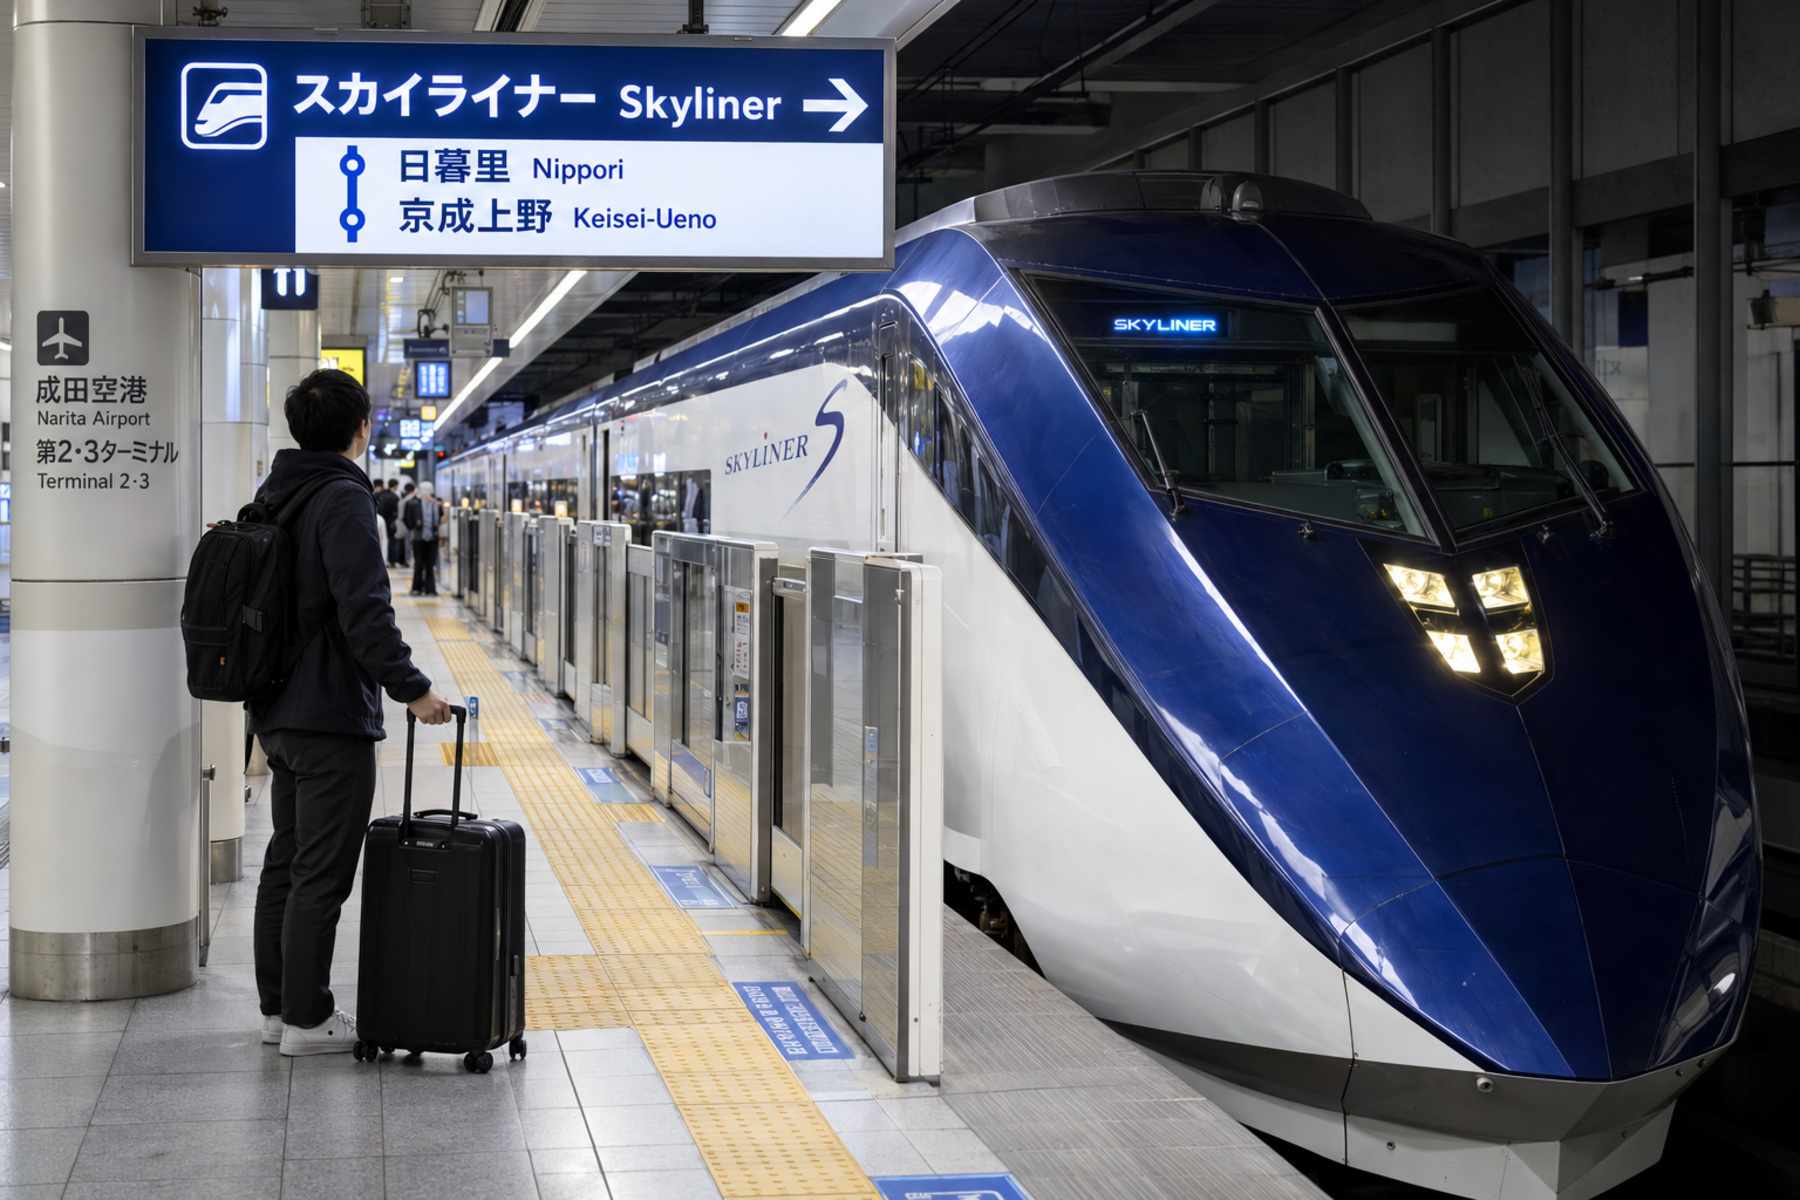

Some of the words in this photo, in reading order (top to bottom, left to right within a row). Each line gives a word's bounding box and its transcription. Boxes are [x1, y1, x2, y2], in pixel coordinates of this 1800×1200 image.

[294, 72, 596, 118] スカイライナー
[619, 84, 782, 128] Skyliner
[400, 147, 511, 184] 日暮里
[533, 157, 624, 184] Nippori
[399, 197, 553, 234] 京成上野
[574, 207, 717, 230] Keisei-Ueno
[1113, 318, 1217, 332] SKYLINER
[36, 375, 147, 404] 成田空港
[37, 410, 86, 426] Narita
[92, 410, 151, 429] Airport
[724, 433, 809, 475] SKYLINER
[37, 472, 113, 490] Terminal
